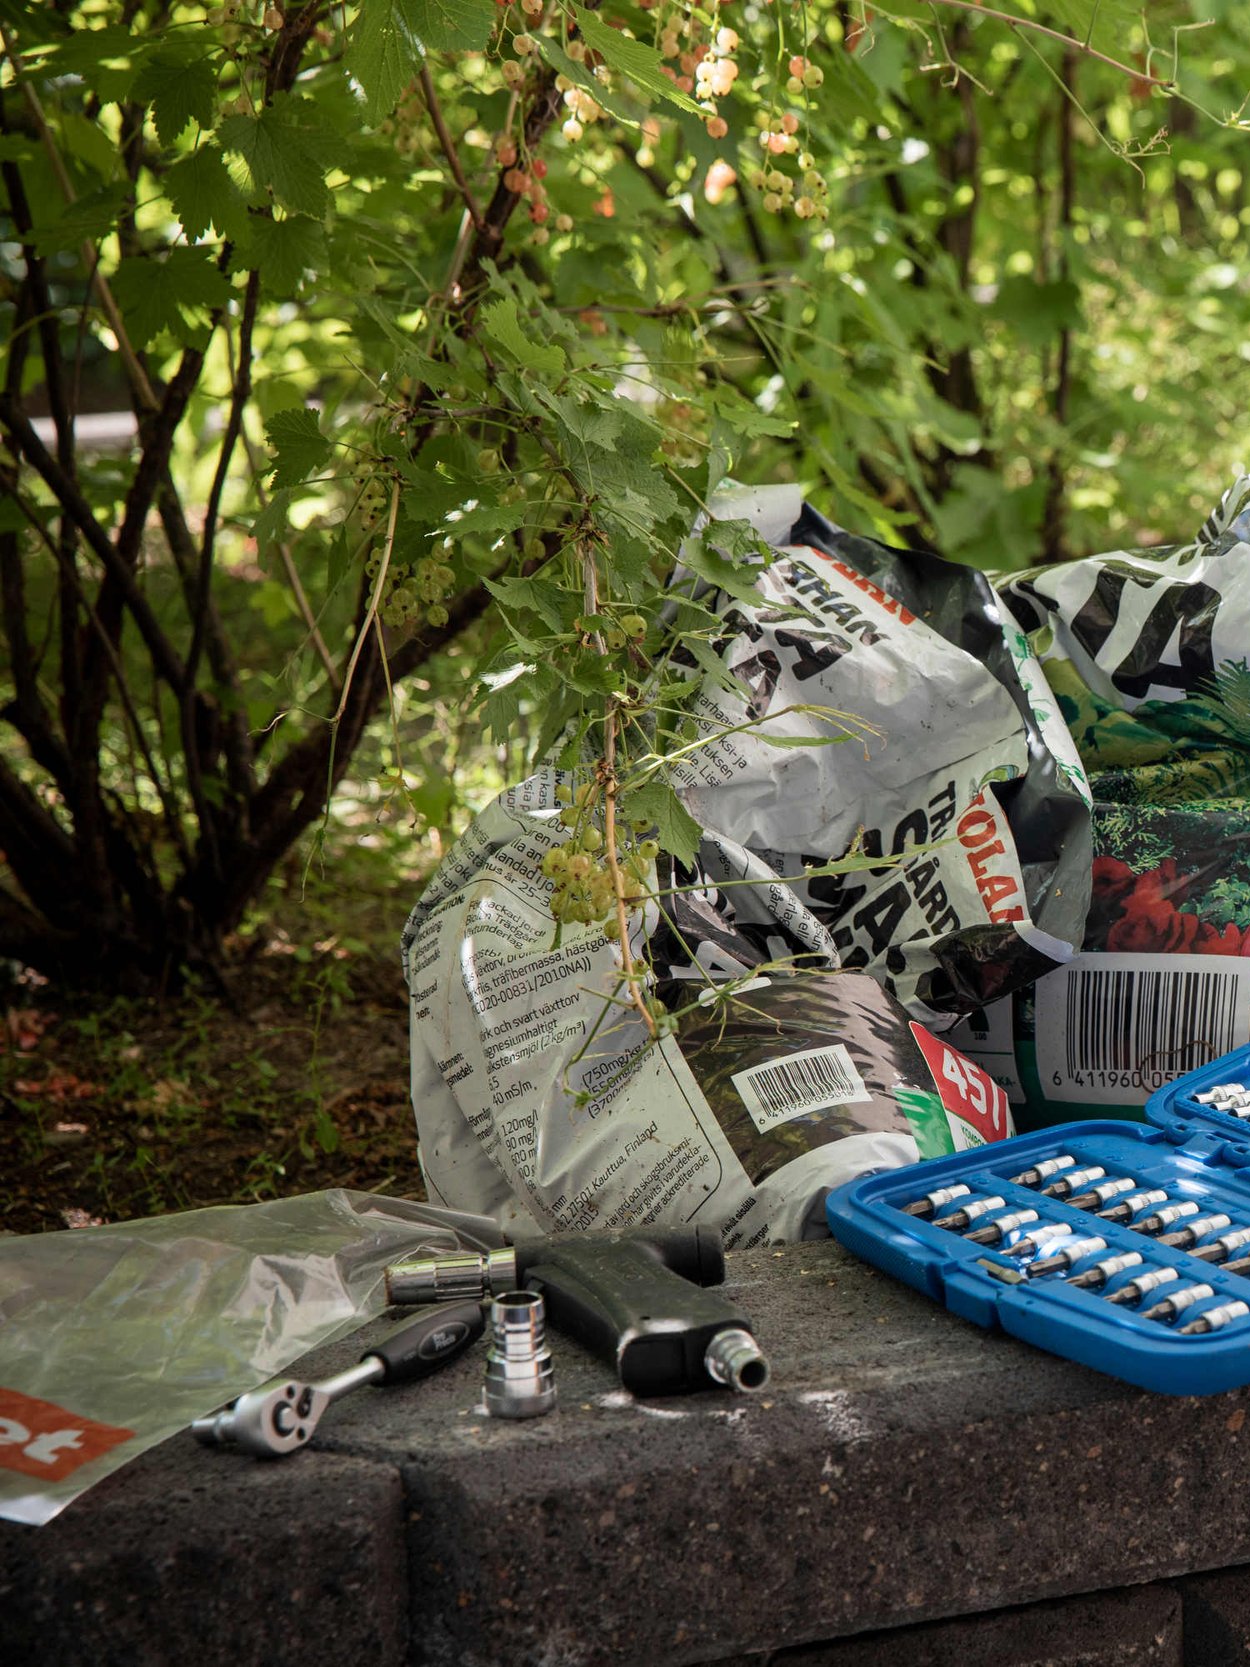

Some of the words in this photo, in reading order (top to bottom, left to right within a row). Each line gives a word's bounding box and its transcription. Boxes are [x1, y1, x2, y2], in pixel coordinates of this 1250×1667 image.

[700, 744, 734, 780] tuksen
[565, 937, 621, 957] hästgö
[494, 1018, 512, 1036] och
[512, 1008, 539, 1028] svart
[539, 992, 581, 1017] växttorv
[485, 1018, 558, 1060] gnesiumhaltigt
[1052, 1070, 1062, 1087] 6
[1075, 1071, 1142, 1088] 411960
[592, 1156, 627, 1192] Kauttua,
[624, 1121, 659, 1157] Finland
[629, 1187, 643, 1204] och
[634, 1202, 647, 1218] har
[644, 1183, 662, 1208] givits
[663, 1144, 702, 1183] varudekla-
[660, 1153, 710, 1205] ackrediterade
[553, 1194, 568, 1213] mm
